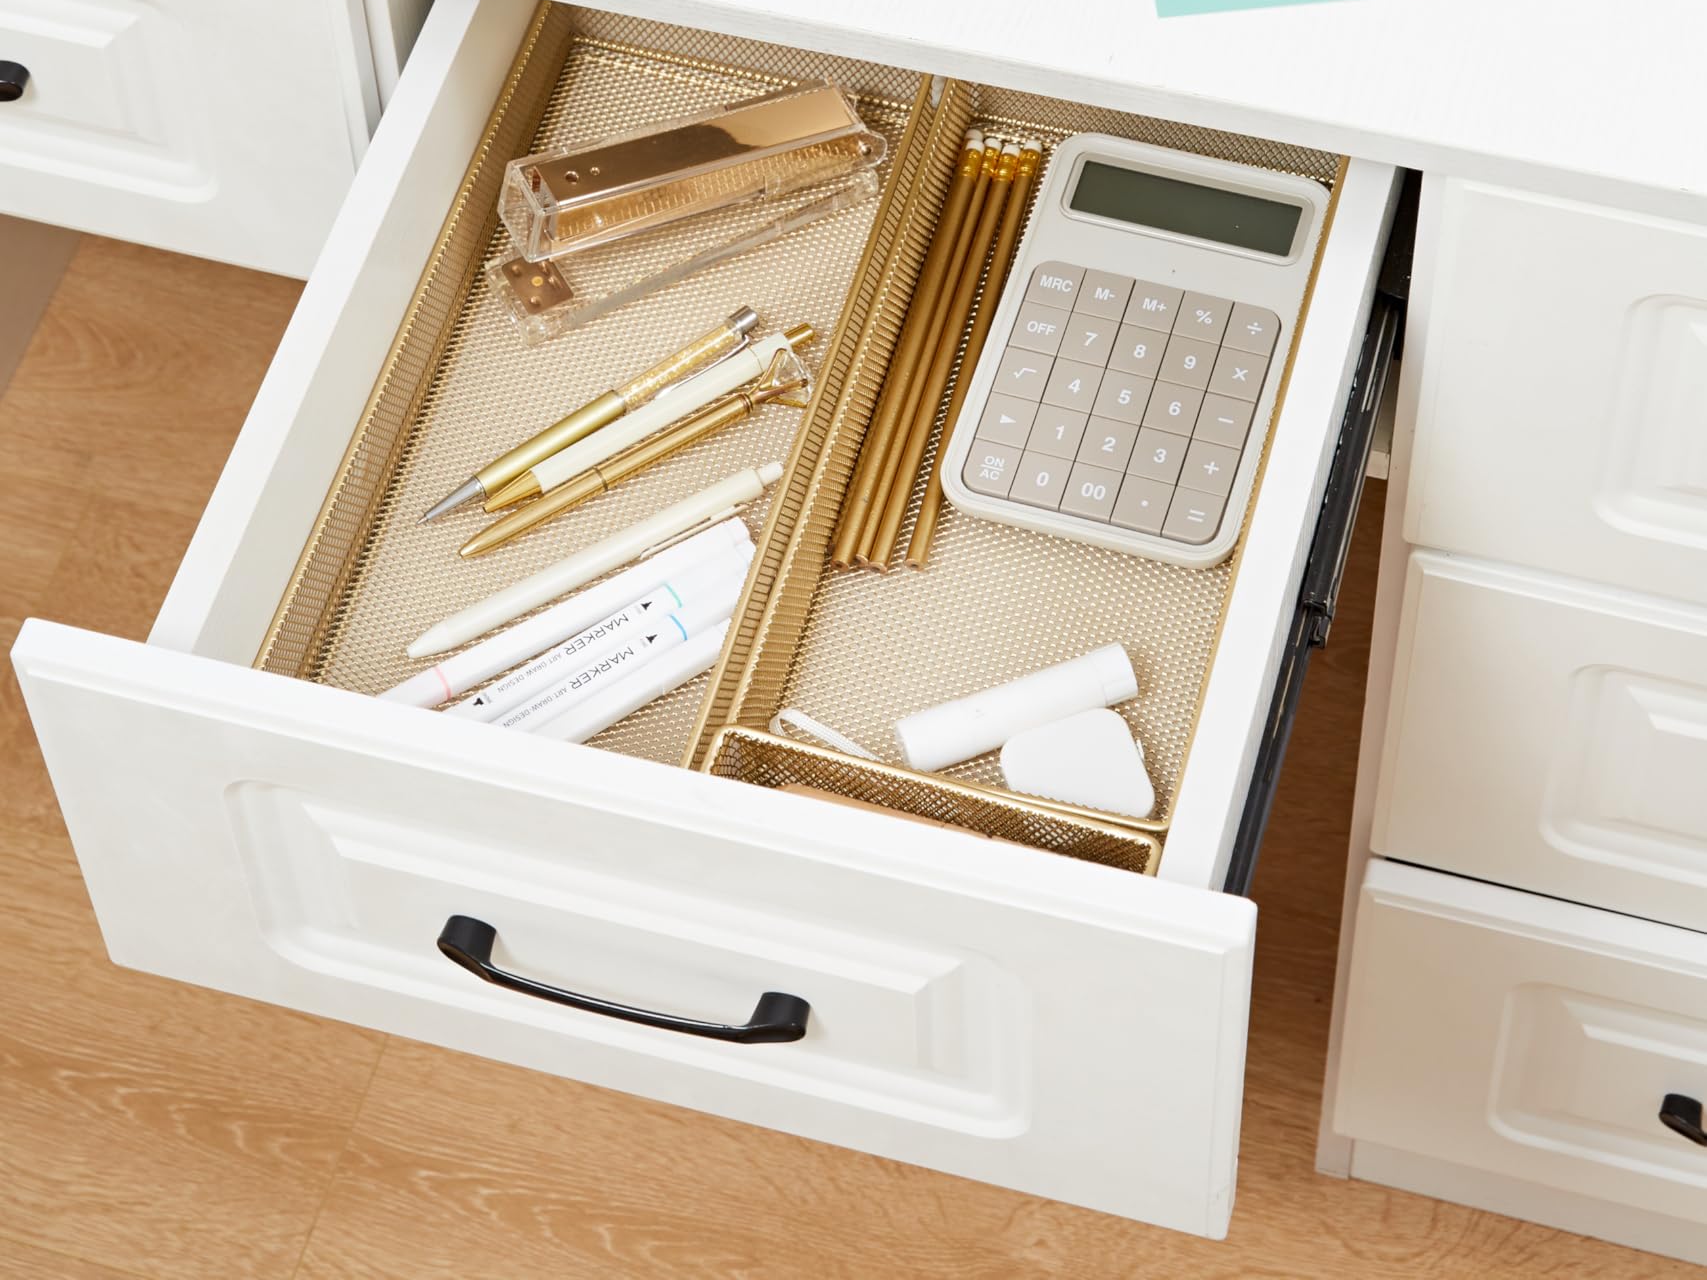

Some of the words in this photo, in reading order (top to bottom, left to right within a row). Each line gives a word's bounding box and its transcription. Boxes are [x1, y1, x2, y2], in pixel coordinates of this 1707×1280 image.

[1039, 275, 1073, 292] MRC
[1094, 287, 1115, 301] M-
[1142, 297, 1167, 312] M+
[1026, 320, 1056, 335] OFF
[1084, 332, 1098, 346] 7
[1134, 344, 1146, 358] 8
[1184, 355, 1196, 369] 9
[1068, 379, 1081, 393] 4
[1118, 390, 1132, 404] 5
[1168, 401, 1181, 415] 6
[984, 455, 1005, 468] ON
[1055, 426, 1064, 440] 1
[1102, 437, 1116, 451] 2
[1153, 449, 1167, 463] 3
[979, 469, 1000, 481] AC
[1036, 472, 1049, 487] 0
[1081, 482, 1106, 500] 00
[565, 613, 630, 656] MARKER
[570, 646, 635, 690] MARKER
